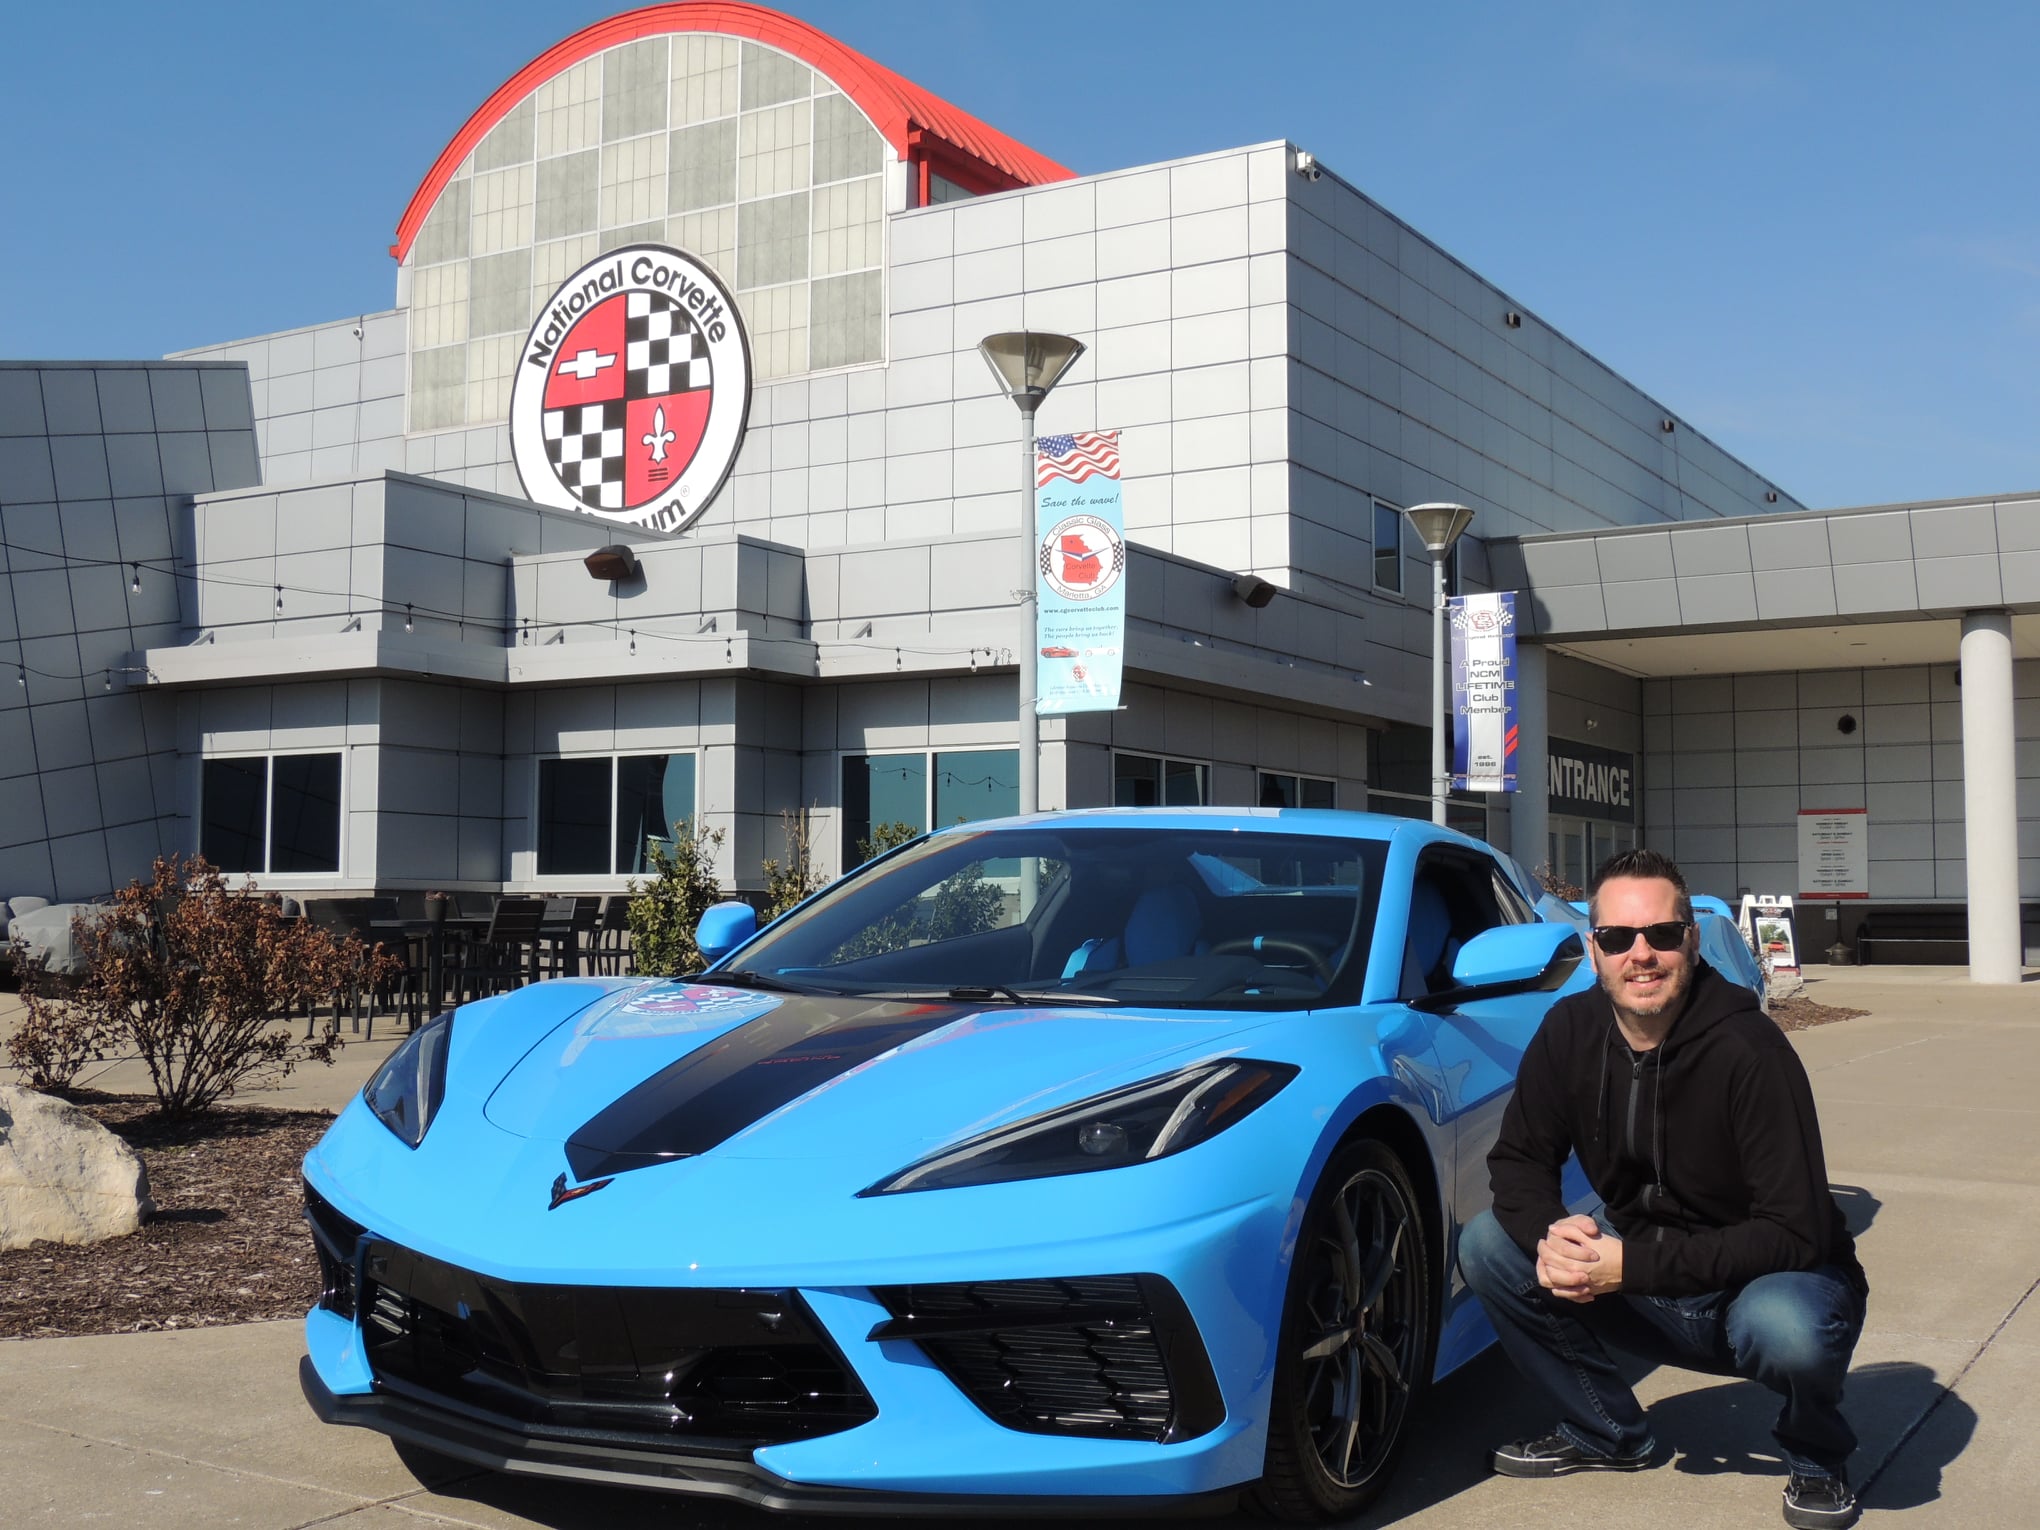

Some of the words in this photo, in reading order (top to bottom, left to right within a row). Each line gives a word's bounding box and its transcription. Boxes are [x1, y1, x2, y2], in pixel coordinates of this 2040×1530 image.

[528, 260, 624, 369] National
[631, 256, 726, 344] Corvette
[1041, 496, 1068, 508] Save
[1071, 495, 1086, 507] the
[1090, 492, 1120, 505] wave!
[1052, 517, 1084, 536] Classic
[1086, 517, 1111, 535] Glass
[1094, 584, 1107, 595] GA
[1459, 659, 1470, 669] A
[1472, 656, 1510, 667] Proud
[1470, 670, 1500, 678] NCM
[1455, 680, 1515, 692] LIFETIME
[1472, 693, 1499, 702] Club
[1460, 705, 1512, 716] Member
[1548, 754, 1631, 807] NTRANCE
